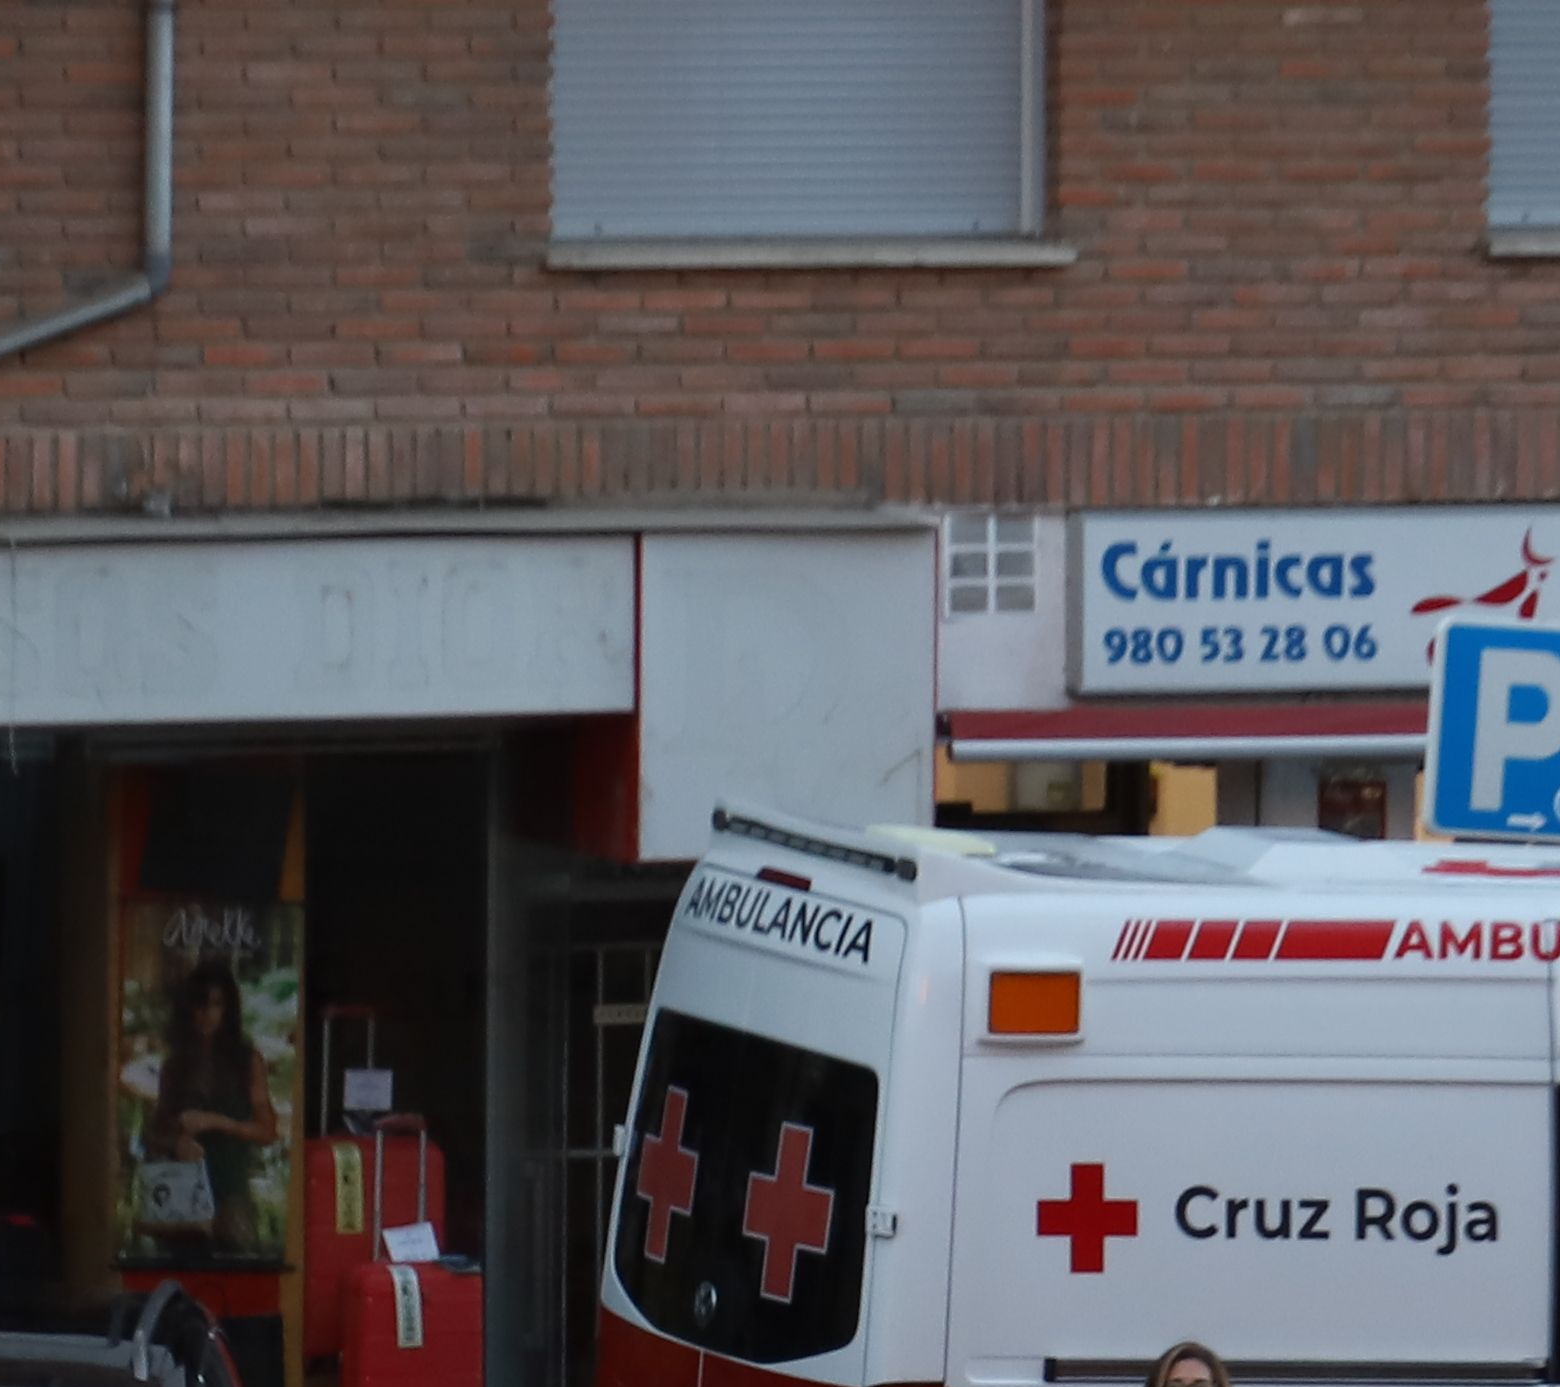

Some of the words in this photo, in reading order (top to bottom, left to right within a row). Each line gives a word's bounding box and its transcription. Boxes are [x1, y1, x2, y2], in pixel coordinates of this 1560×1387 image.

[1100, 540, 1377, 601] Cárnicas
[1103, 628, 1184, 664] 980
[1200, 627, 1244, 664] 53
[1260, 626, 1308, 663] 28
[1323, 624, 1378, 661] 06
[685, 877, 873, 964] AMBULANCIA
[1174, 1185, 1330, 1243] Cruz
[1354, 1181, 1498, 1256] Roja
